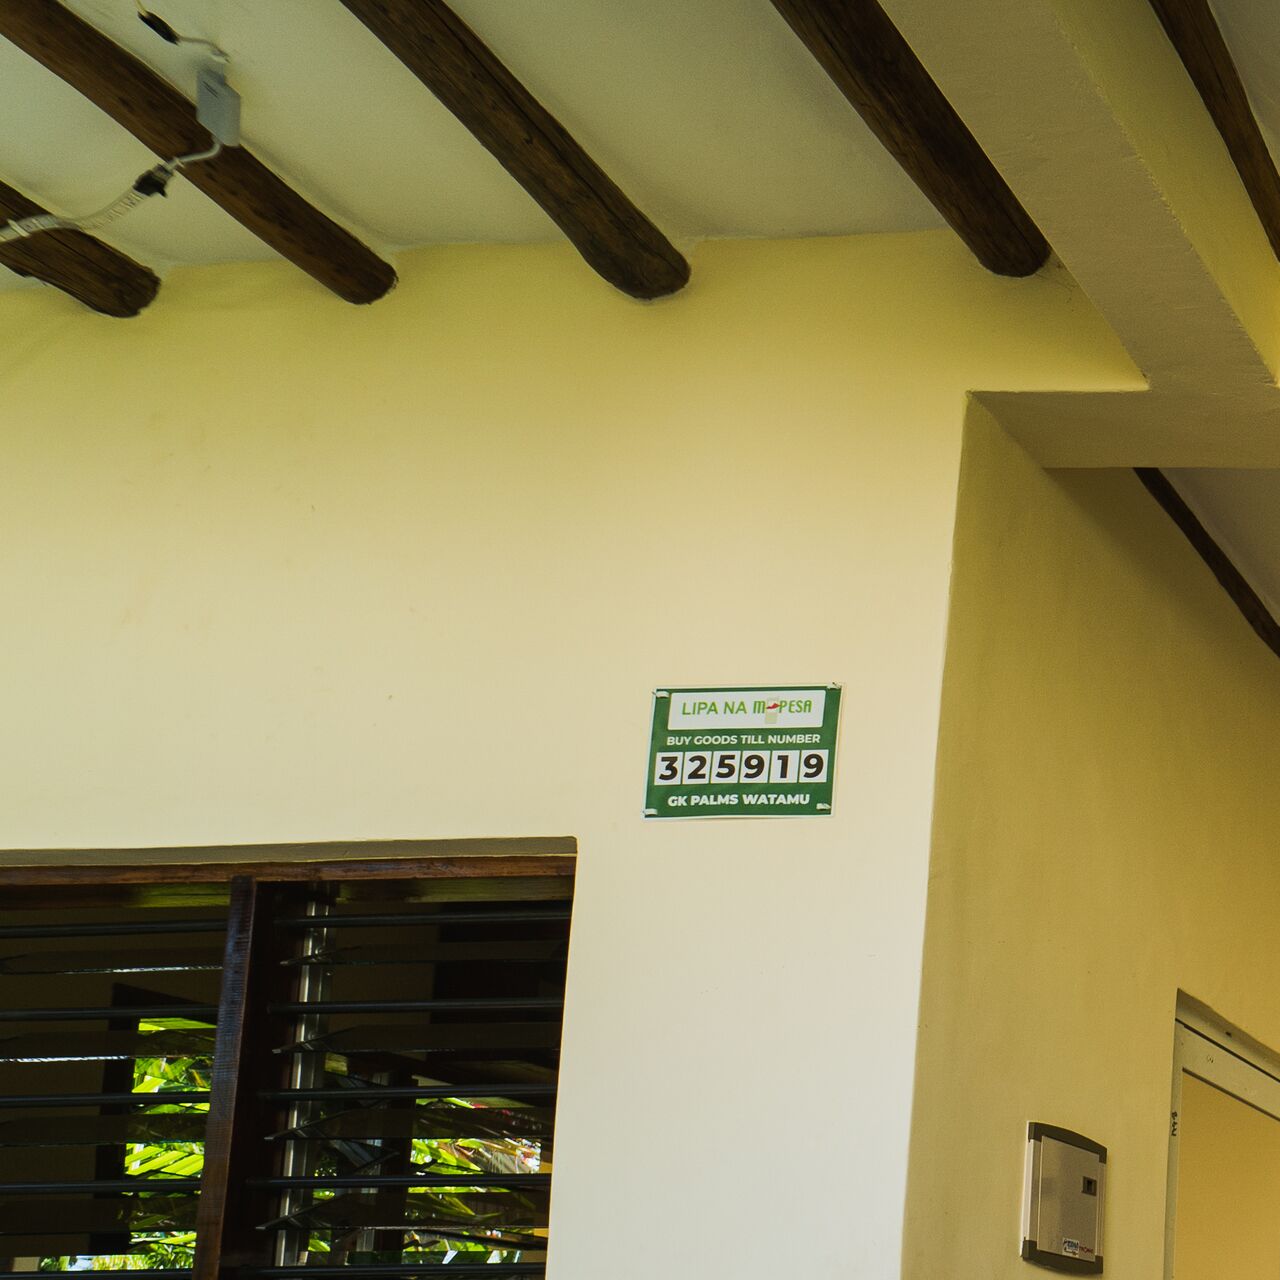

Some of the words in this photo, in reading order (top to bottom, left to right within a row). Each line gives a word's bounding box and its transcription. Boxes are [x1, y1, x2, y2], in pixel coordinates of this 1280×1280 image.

[681, 700, 719, 715] LIPA
[723, 700, 747, 715] NA
[666, 735, 691, 746] BUY
[693, 735, 738, 745] GOODS
[740, 734, 765, 745] TILL
[767, 734, 821, 744] NUMBER
[667, 795, 687, 806] GK
[690, 794, 739, 806] PALMS
[742, 794, 810, 805] WATAMU
